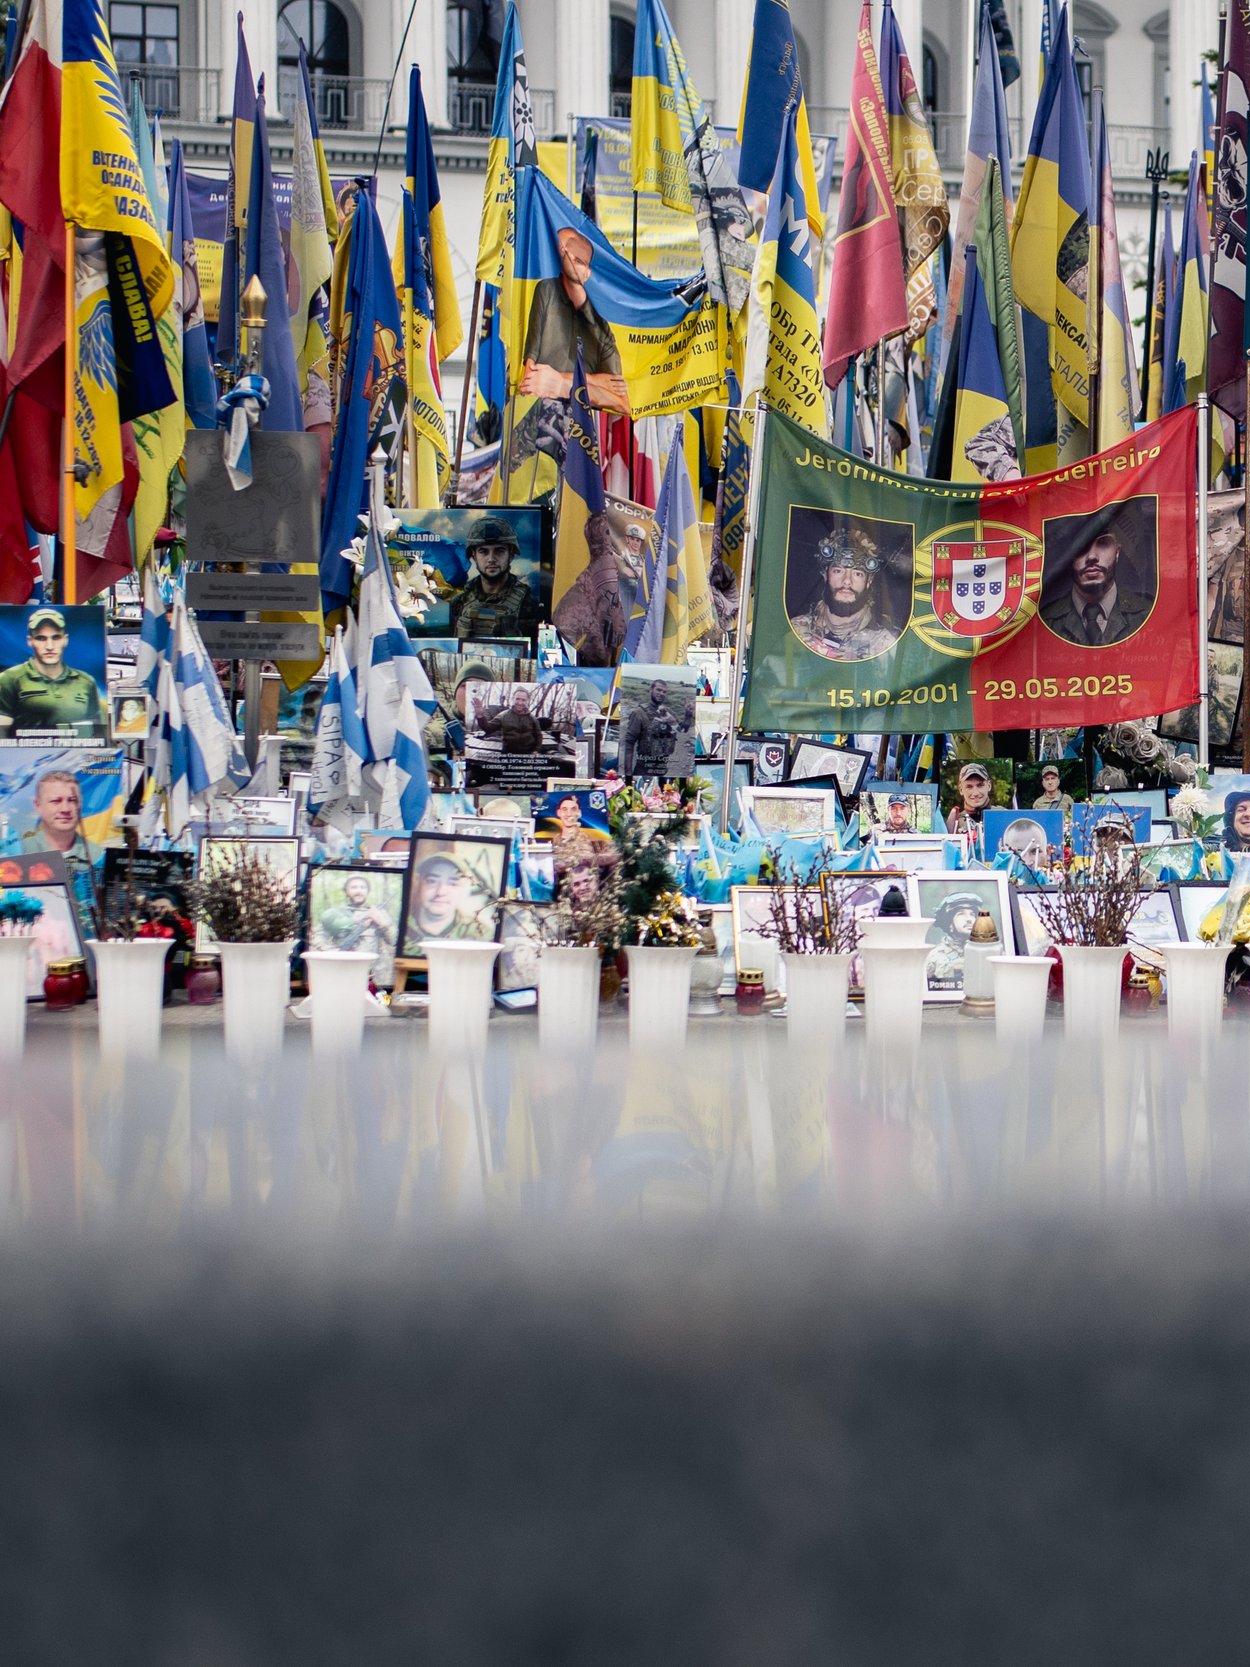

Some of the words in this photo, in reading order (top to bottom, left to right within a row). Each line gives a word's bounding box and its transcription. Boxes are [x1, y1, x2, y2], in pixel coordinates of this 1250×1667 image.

[114, 256, 153, 344] СЛАВА!
[661, 381, 696, 399] КОМАНДИР
[771, 363, 817, 409] А7320
[795, 446, 919, 491] Jerónimo
[826, 682, 960, 709] 15.10.2001
[983, 674, 1134, 701] 29.05.2025
[929, 980, 956, 989] Роман
